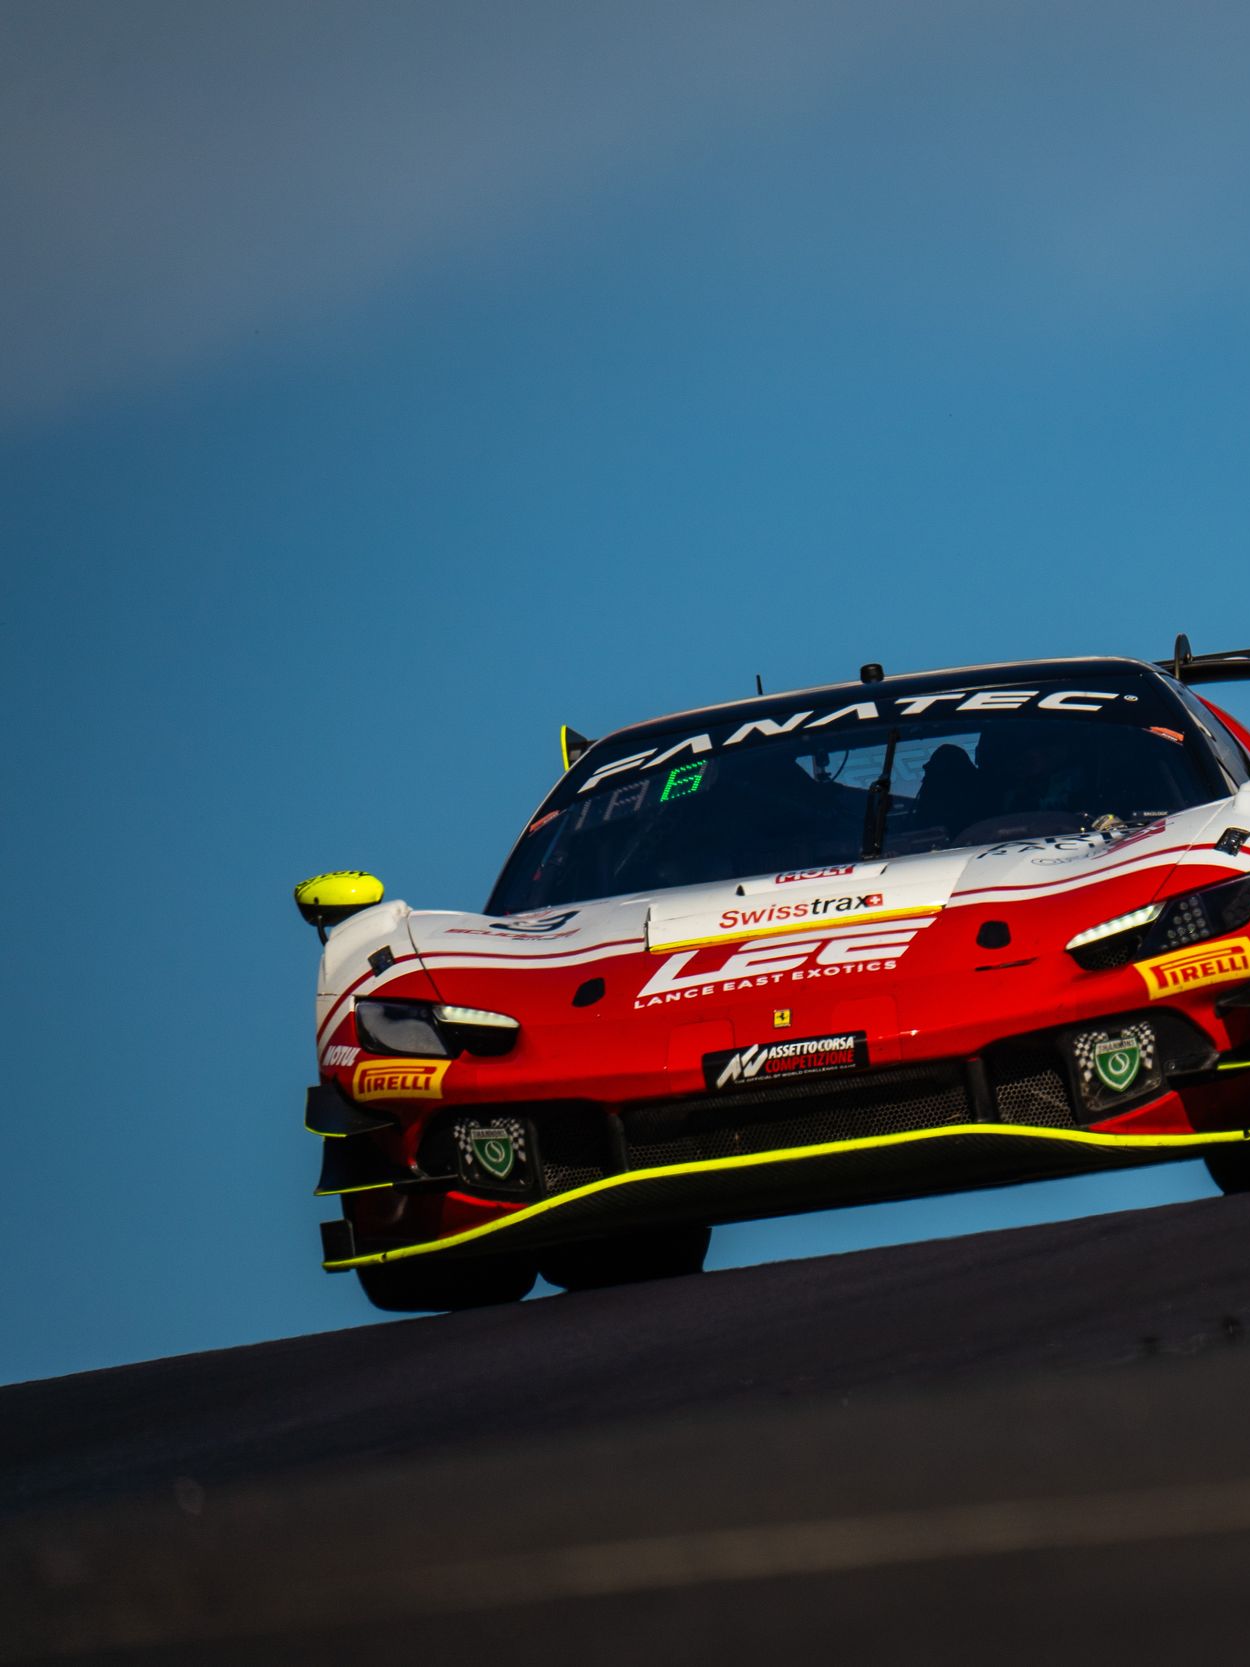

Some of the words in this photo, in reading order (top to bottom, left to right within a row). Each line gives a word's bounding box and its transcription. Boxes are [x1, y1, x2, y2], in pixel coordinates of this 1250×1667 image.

[577, 691, 1119, 793] FANATEC
[719, 895, 868, 929] Swisstrax
[636, 917, 938, 998] LEE
[1150, 946, 1249, 990] PIRELLI
[634, 985, 715, 1009] LANCE
[723, 973, 784, 992] EAST
[791, 959, 897, 981] EXOTICS
[323, 1046, 361, 1067] MOTUL
[765, 1050, 855, 1073] COMPETIZIONE
[359, 1067, 437, 1094] PIRELLI
